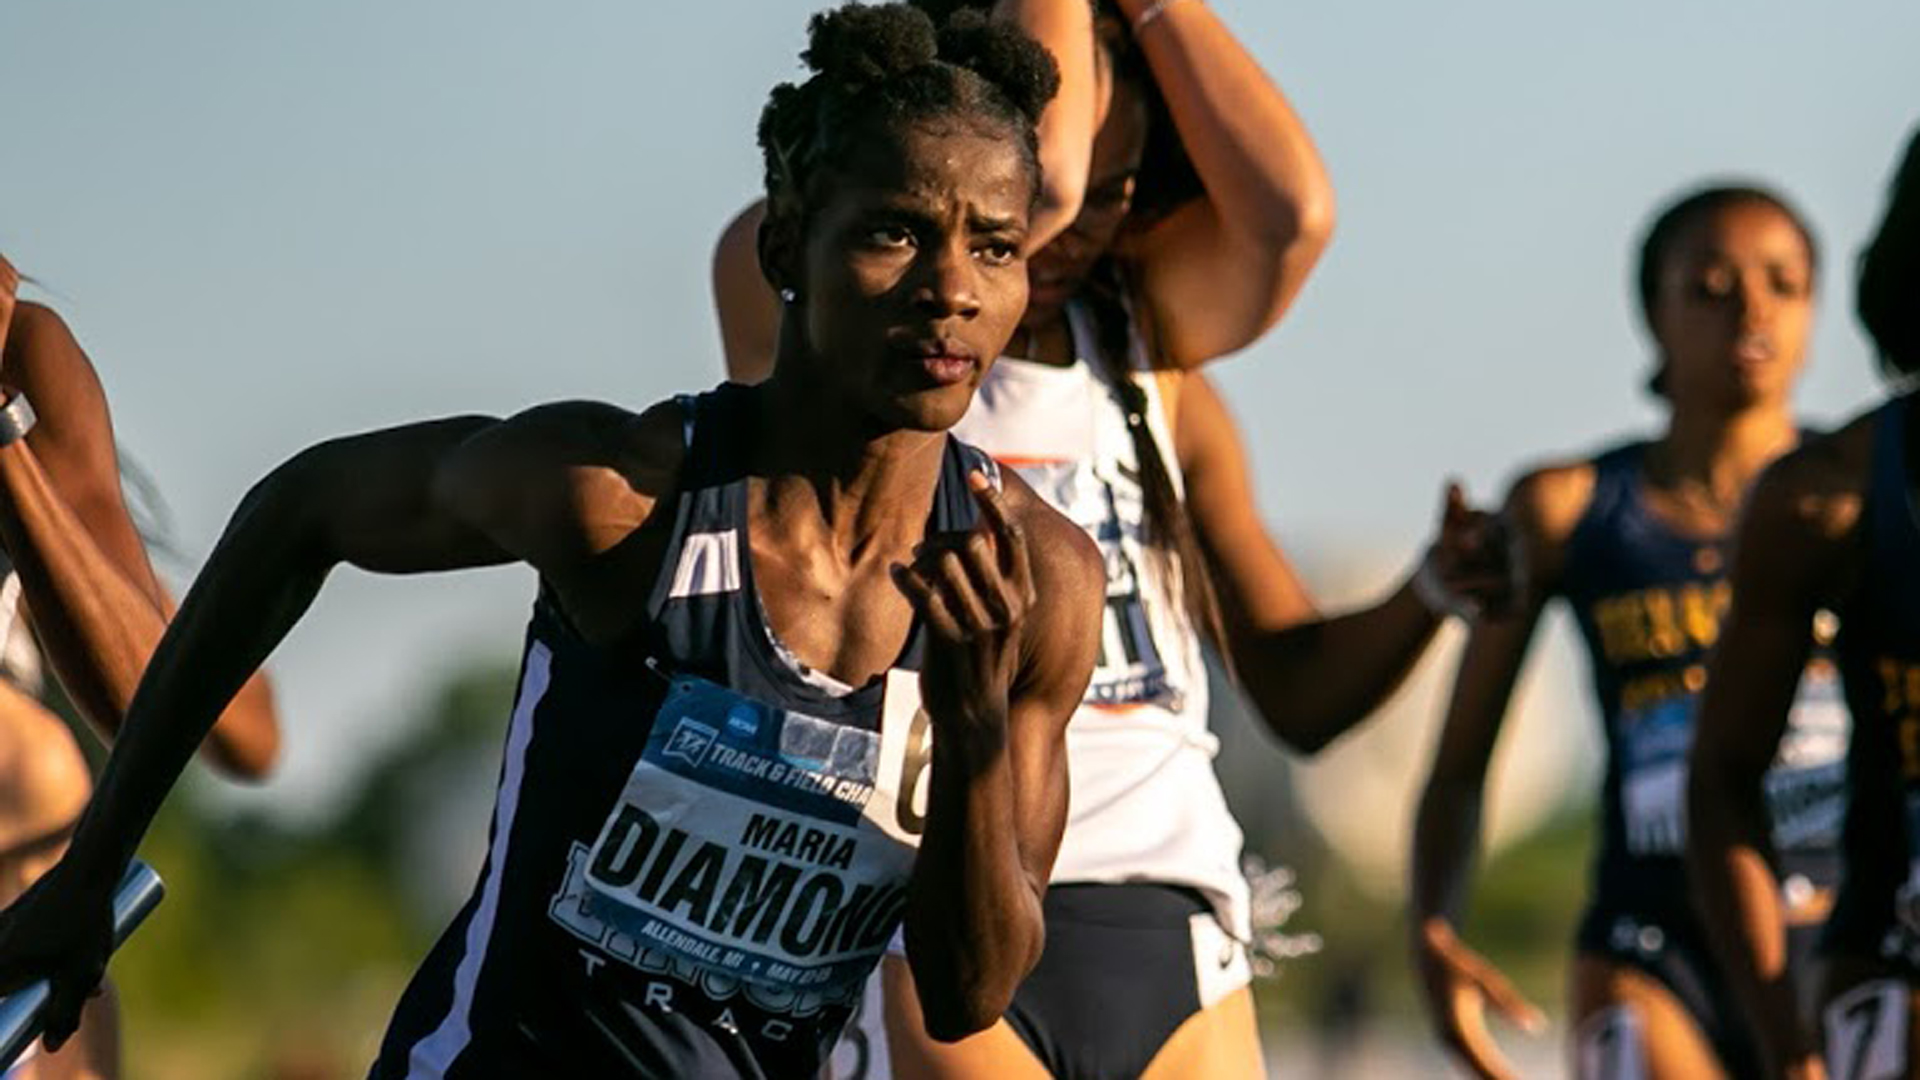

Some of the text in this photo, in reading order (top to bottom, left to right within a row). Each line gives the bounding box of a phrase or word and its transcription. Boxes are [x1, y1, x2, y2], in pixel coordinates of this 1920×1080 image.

[710, 743, 768, 780] TRACK
[767, 763, 784, 781] &
[783, 768, 835, 796] FIELD
[740, 813, 857, 870] MARIA
[589, 804, 906, 958] DIAMOND
[578, 949, 826, 1041] TRAC
[721, 951, 746, 968] MI
[766, 963, 801, 982] MAY
